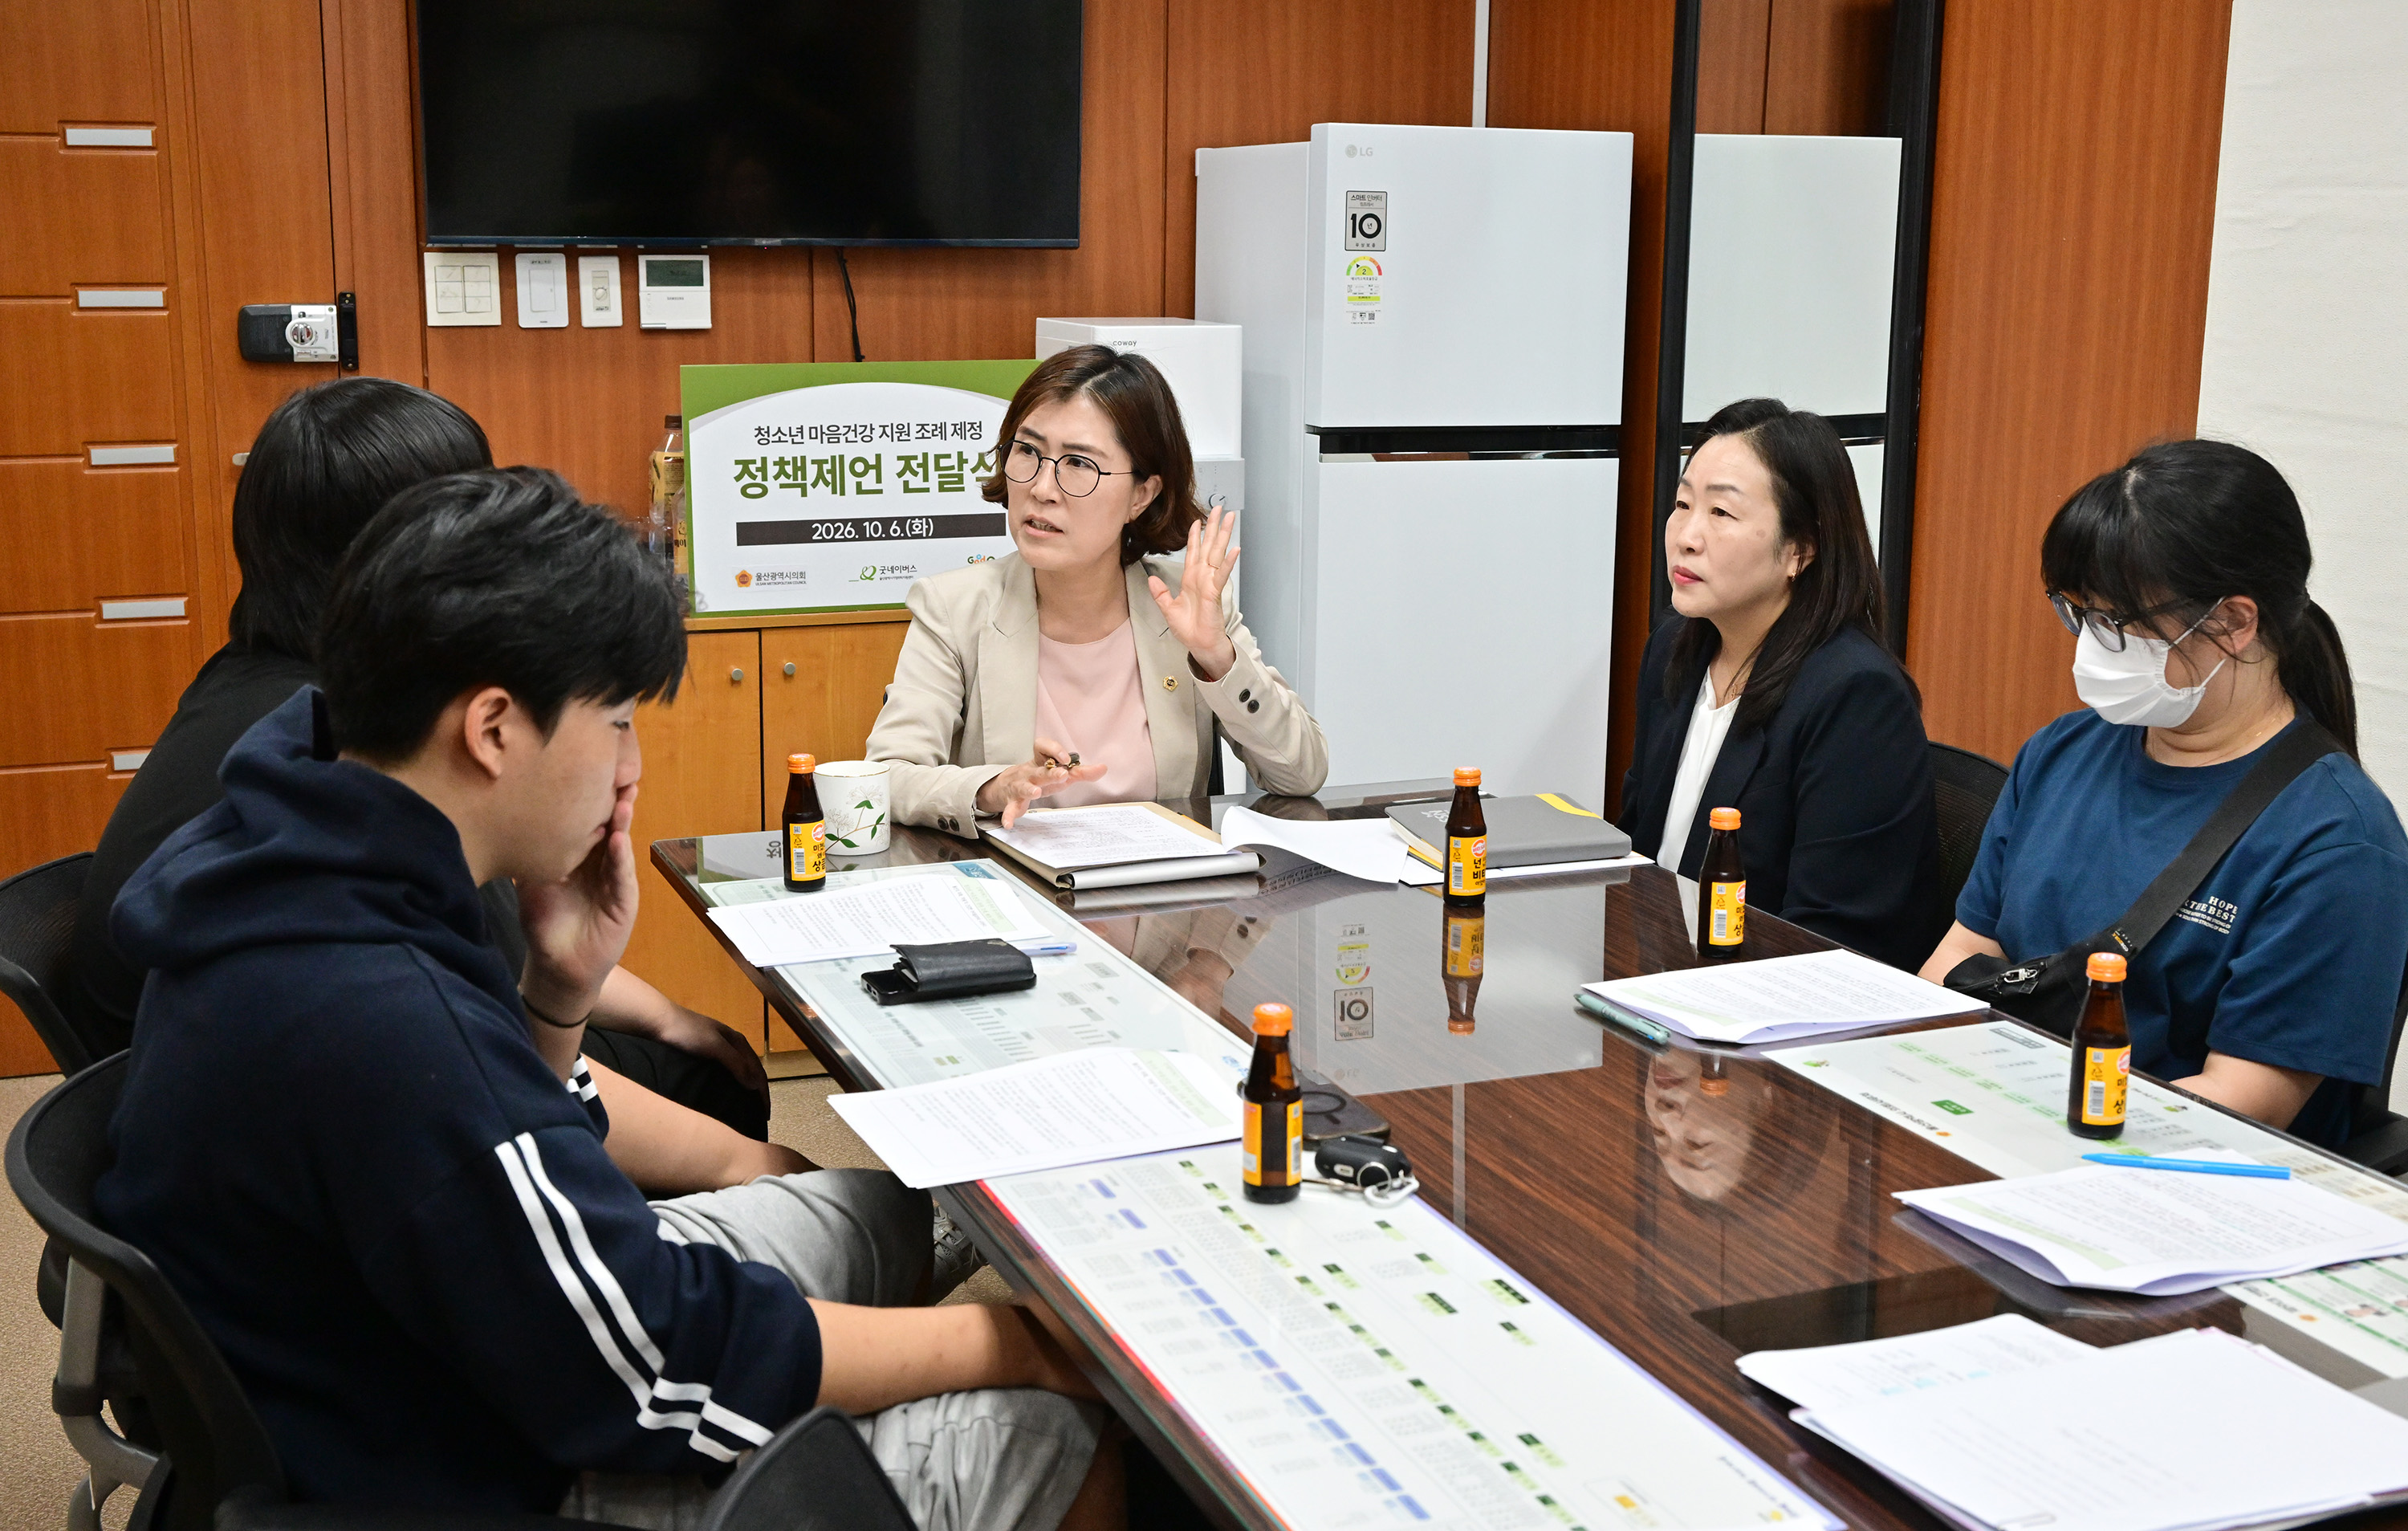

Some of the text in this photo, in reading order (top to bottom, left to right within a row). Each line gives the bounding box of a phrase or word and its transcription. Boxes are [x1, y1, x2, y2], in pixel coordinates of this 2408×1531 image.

[1360, 147, 1373, 157] LG
[1350, 213, 1382, 238] 10
[754, 420, 983, 446] 청소년 마음건강 지원 조례 제정
[734, 454, 884, 499] 정책제언
[811, 522, 859, 540] 2026.
[863, 520, 886, 538] 10.
[755, 571, 806, 581] 울산광역시의회
[879, 564, 917, 575] 굿네이버스
[2190, 900, 2208, 912] THE
[2207, 905, 2236, 923] BEST
[2208, 895, 2239, 914] HOPE
